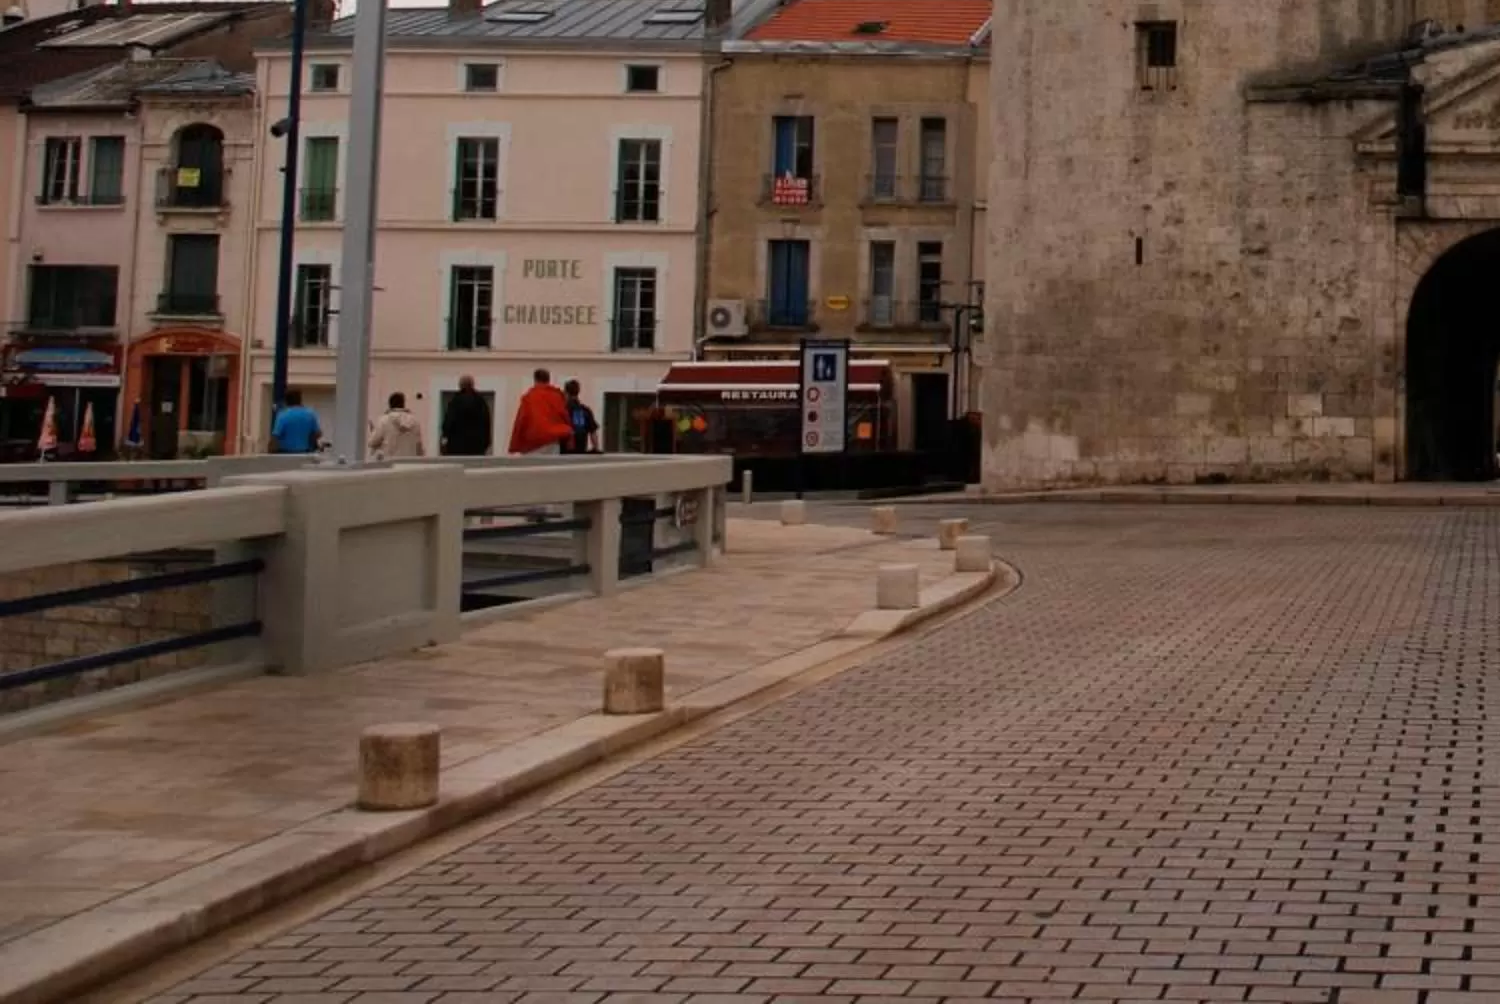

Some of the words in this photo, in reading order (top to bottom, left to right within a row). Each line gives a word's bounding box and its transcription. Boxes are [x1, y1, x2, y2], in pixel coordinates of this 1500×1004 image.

[523, 259, 582, 279] PORTE
[504, 304, 598, 325] CHAUSSEE
[721, 390, 798, 400] RESTAURA
